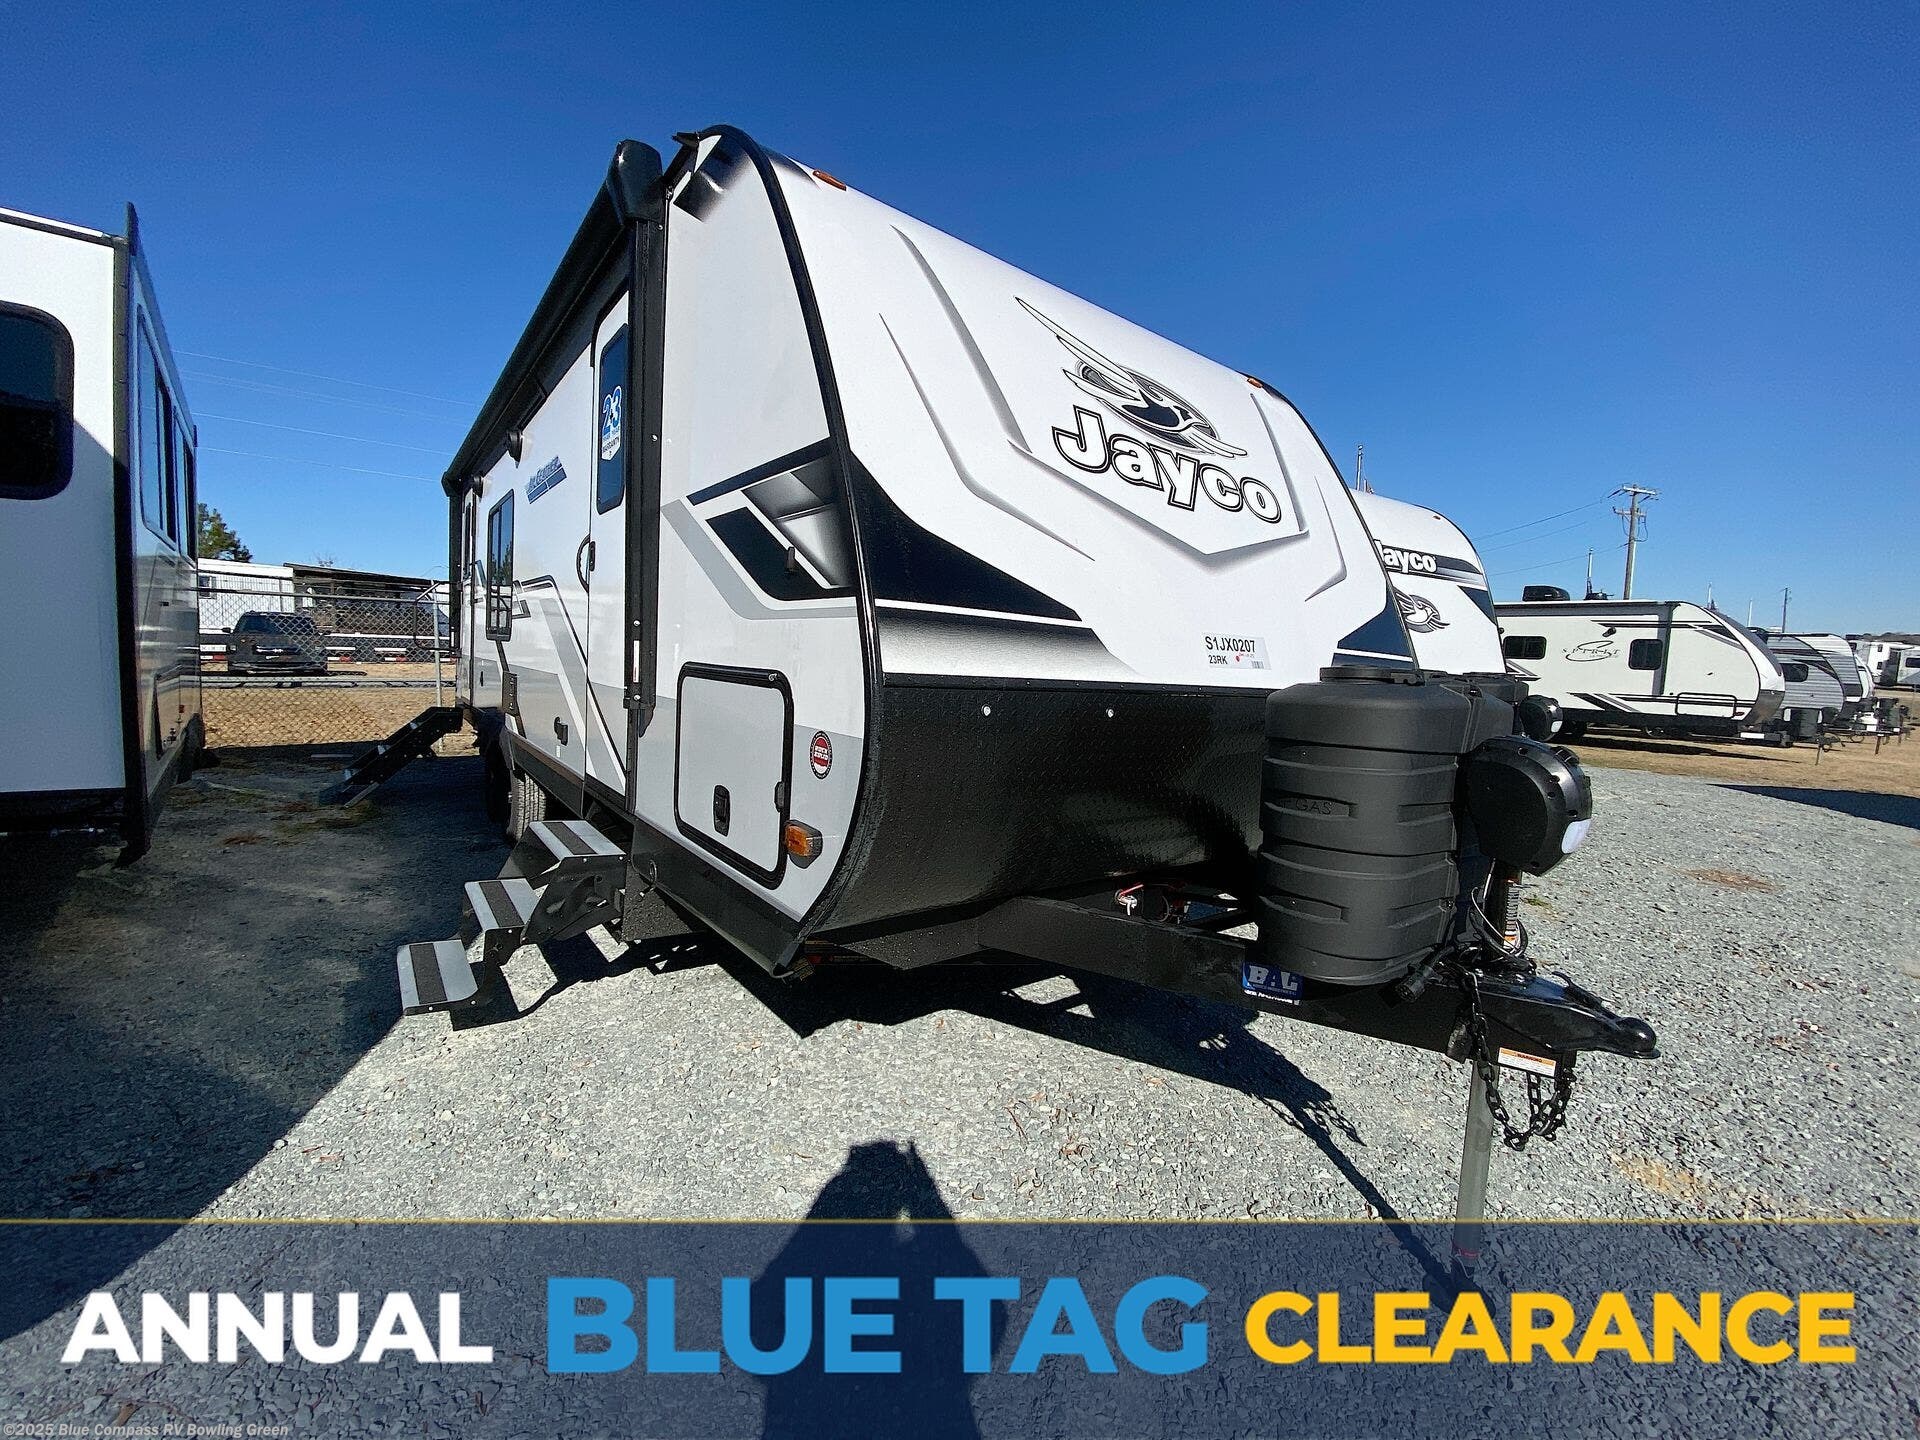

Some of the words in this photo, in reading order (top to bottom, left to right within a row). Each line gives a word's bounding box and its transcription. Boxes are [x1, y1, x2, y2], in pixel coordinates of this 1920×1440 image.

[1052, 405, 1282, 524] Jayco
[1204, 636, 1255, 653] S1JX0207
[1208, 654, 1228, 665] 23RK
